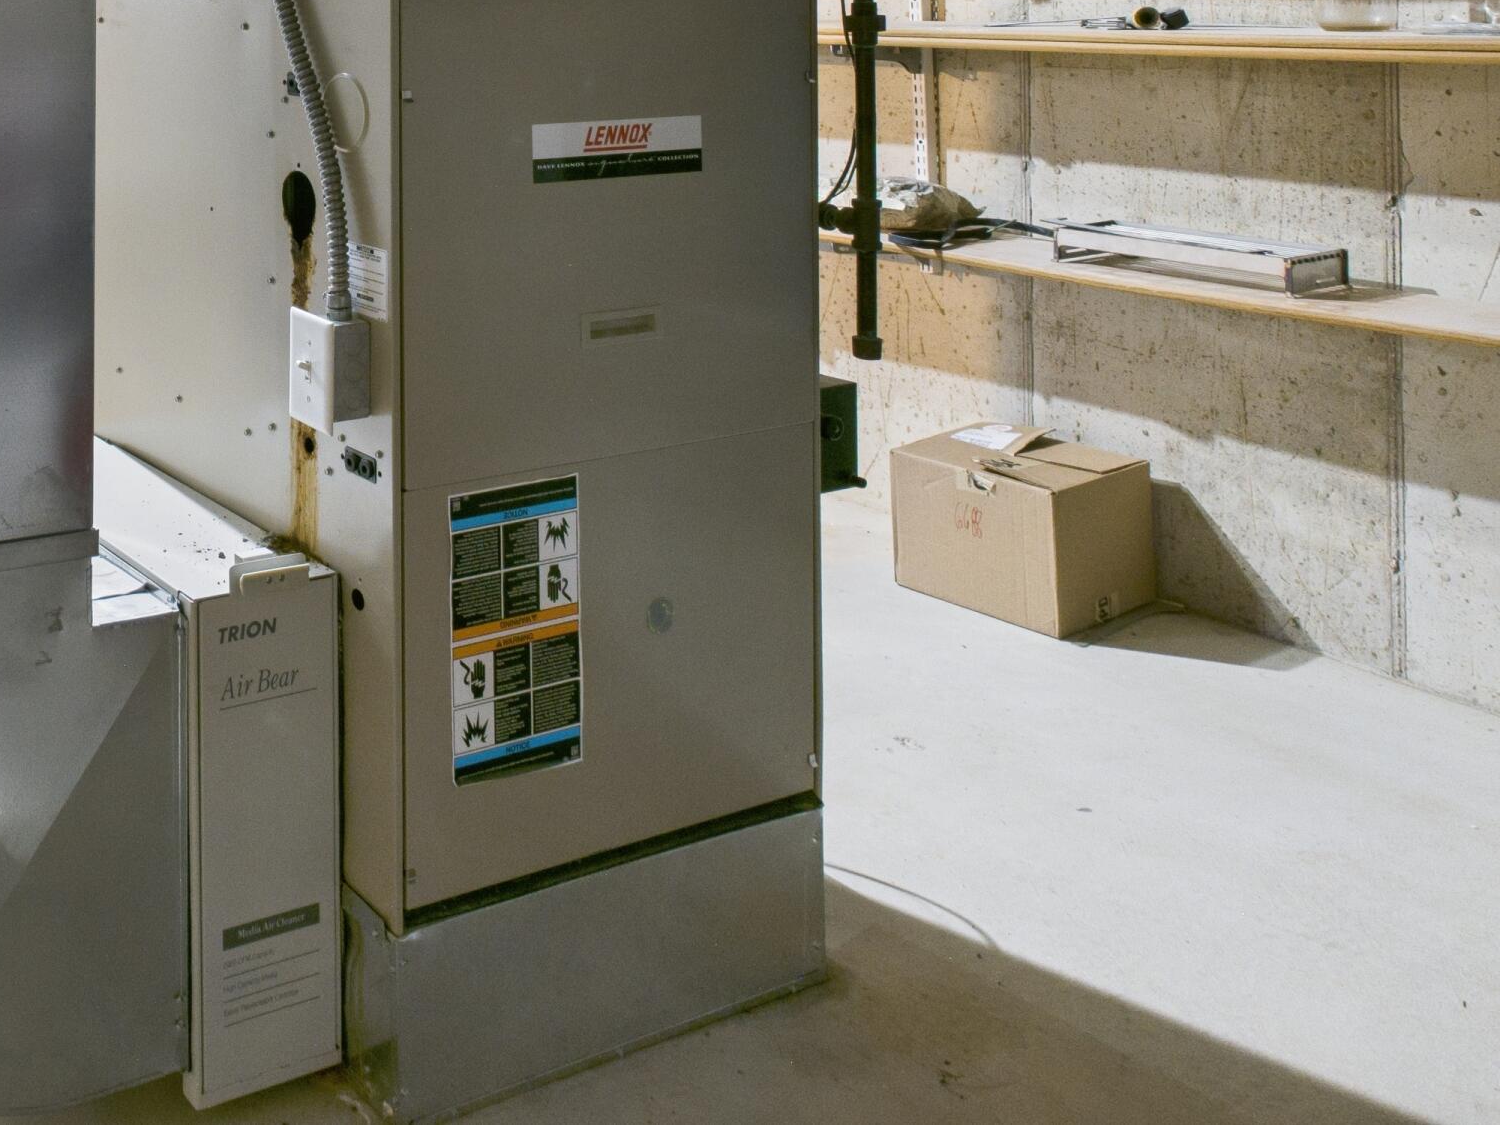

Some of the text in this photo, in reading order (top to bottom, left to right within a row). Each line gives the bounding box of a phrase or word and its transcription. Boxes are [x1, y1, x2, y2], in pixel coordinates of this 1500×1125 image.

[584, 123, 652, 146] LENNOX
[556, 161, 586, 170] LENNOX
[657, 153, 700, 163] COLLECTION
[218, 618, 277, 644] TRION
[221, 668, 299, 701] Air Bear
